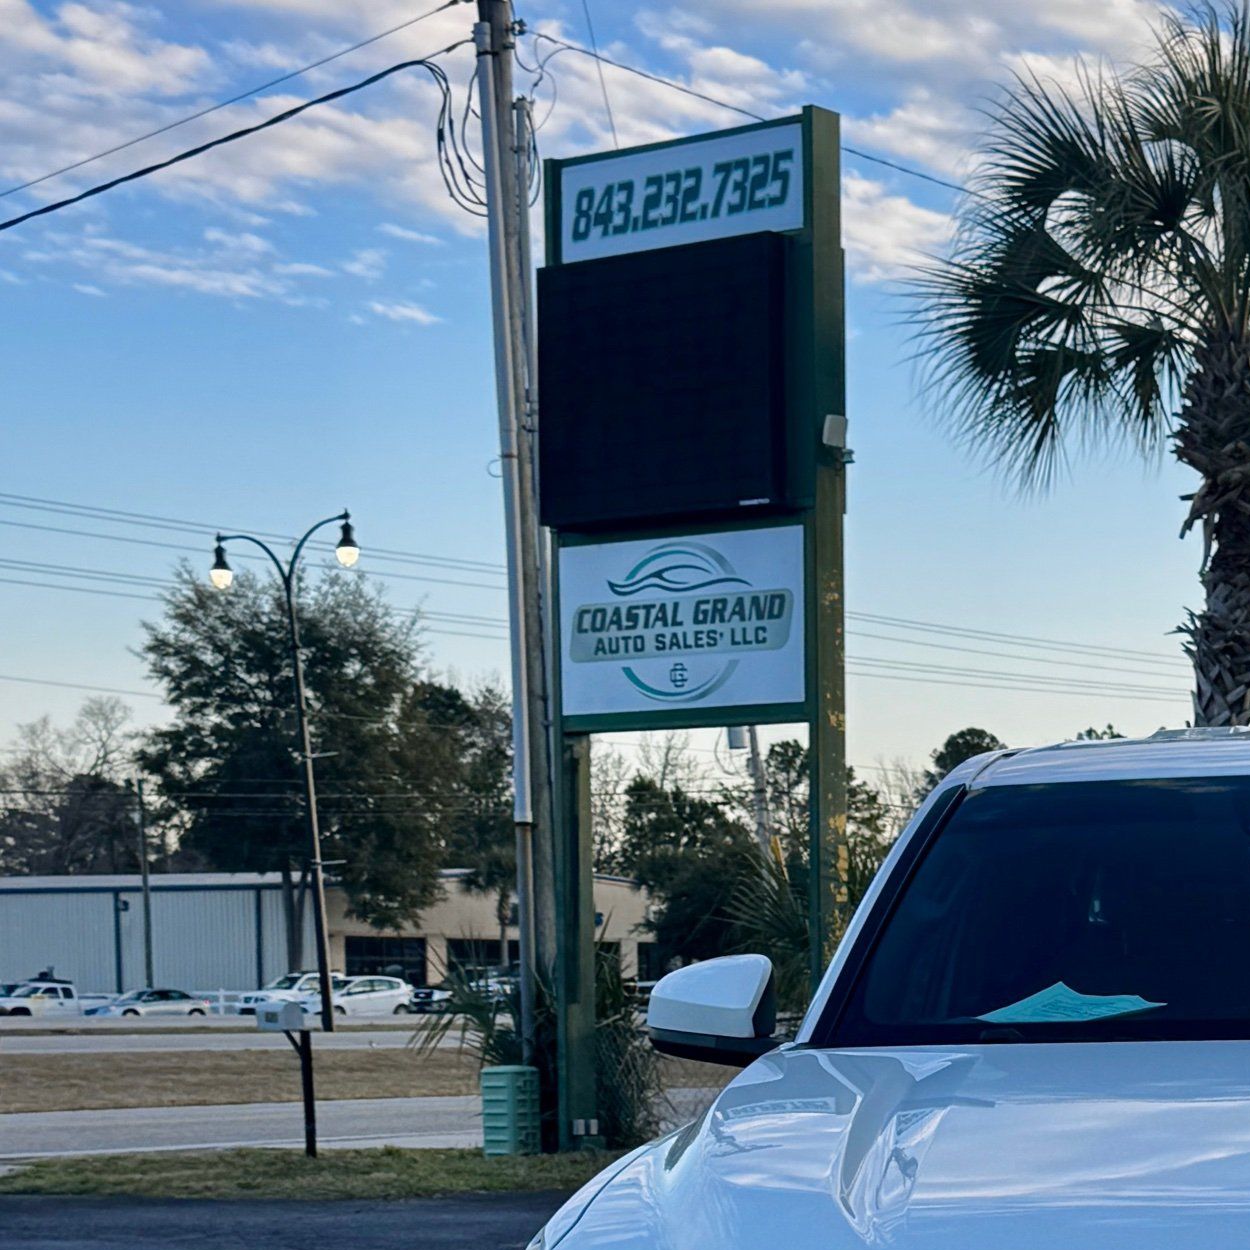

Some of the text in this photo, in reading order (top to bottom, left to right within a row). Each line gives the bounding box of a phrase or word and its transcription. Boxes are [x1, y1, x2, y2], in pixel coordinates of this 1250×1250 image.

[571, 148, 794, 243] 843.232.7325
[576, 593, 786, 634] COASTAL GRAND
[594, 634, 646, 656] AUTO
[730, 626, 768, 646] LLC
